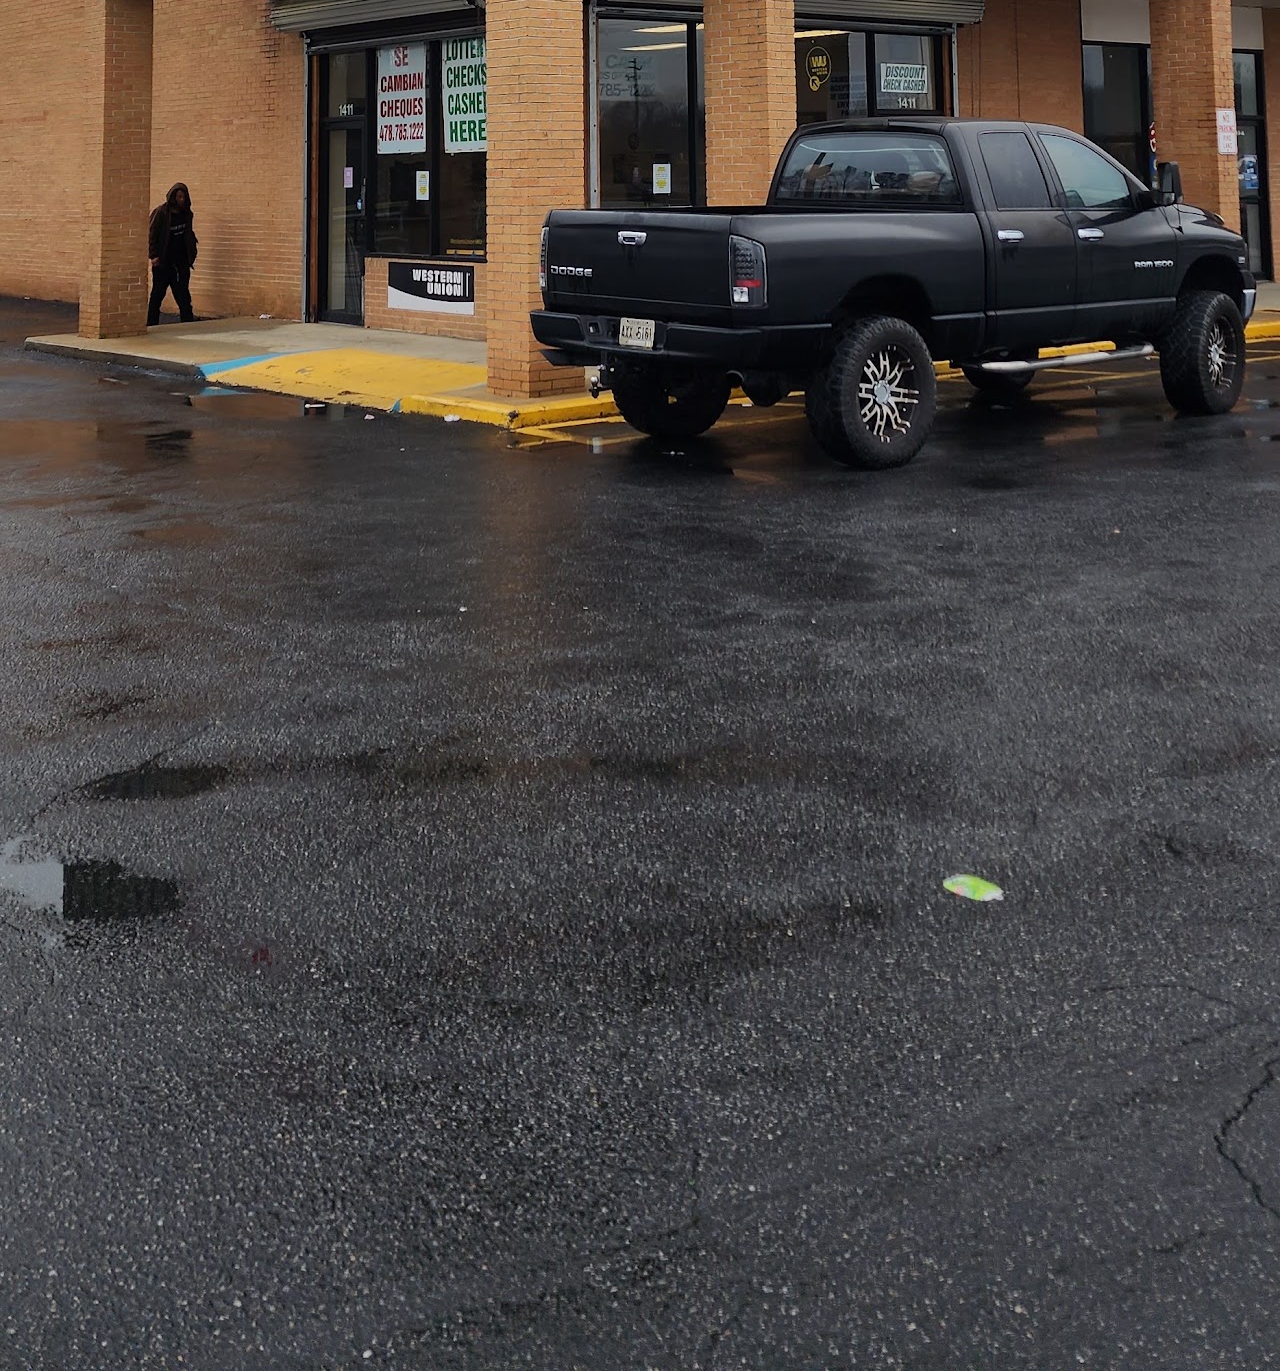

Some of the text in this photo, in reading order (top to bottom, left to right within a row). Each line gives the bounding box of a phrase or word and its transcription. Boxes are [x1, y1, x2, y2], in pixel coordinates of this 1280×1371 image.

[394, 47, 409, 67] SE
[446, 37, 486, 61] LOTTER
[446, 63, 487, 88] CHECKS
[885, 66, 925, 79] DISCOUNT
[381, 72, 424, 93] CAMBIAN
[883, 78, 902, 90] CHECK
[338, 103, 354, 117] 1411
[381, 97, 424, 119] CHEQUES
[898, 97, 916, 109] 1411
[379, 122, 424, 141] 478.785.1222
[450, 119, 487, 142] HERE
[412, 268, 461, 283] WESTERN
[550, 265, 592, 277] DODGE
[427, 282, 461, 297] UNION
